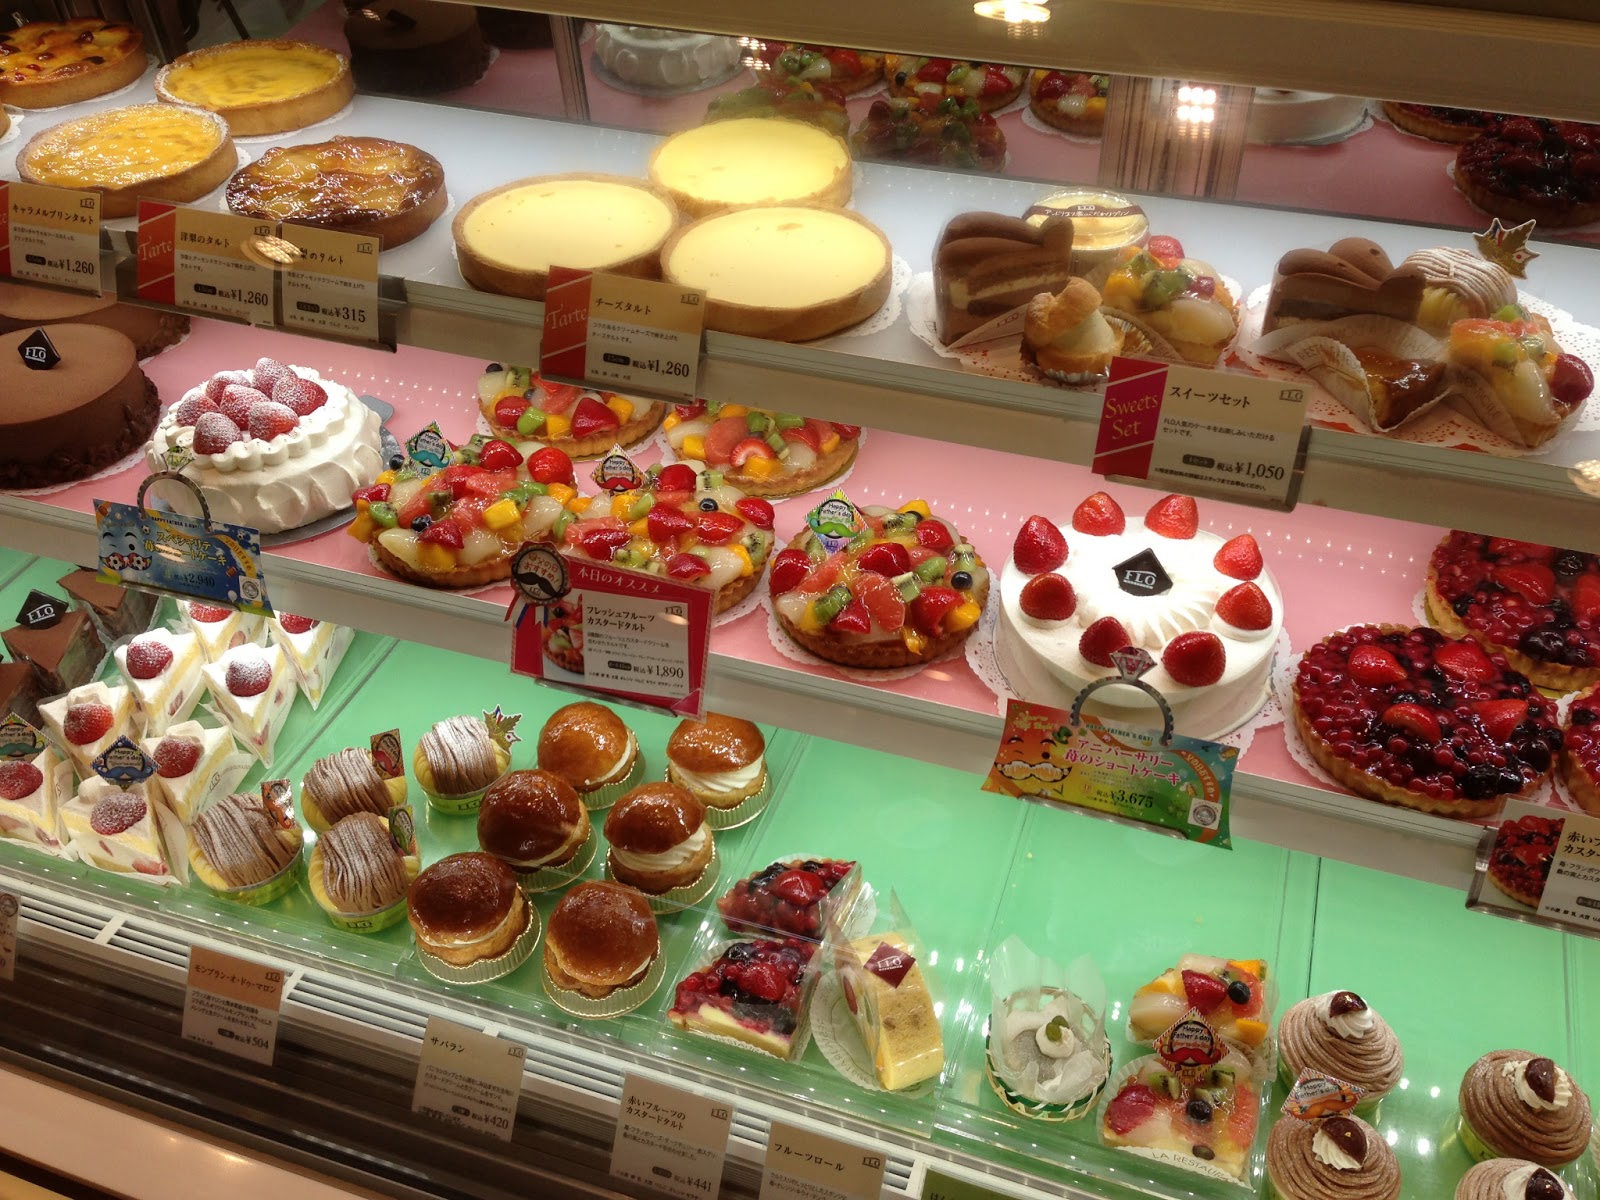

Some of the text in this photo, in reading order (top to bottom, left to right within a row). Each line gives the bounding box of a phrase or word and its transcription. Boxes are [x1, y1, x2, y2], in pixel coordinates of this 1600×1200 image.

[80, 198, 95, 209] FLO
[13, 204, 93, 224] キャラメルプリンタルト
[181, 232, 229, 248] 洋梨のタルト
[254, 225, 270, 236] FLO
[138, 235, 172, 261] Tarte
[291, 247, 344, 265] 梨のタルト
[595, 298, 651, 316] チーズタルト
[680, 293, 700, 306] FLO
[546, 304, 587, 330] Tarte
[25, 346, 47, 362] FLO
[1168, 386, 1250, 409] スイーツセット
[1279, 389, 1304, 403] FLO
[1105, 394, 1159, 419] Sweets
[1111, 419, 1142, 440] Set
[1234, 461, 1285, 481] ¥1,050
[144, 539, 227, 566] 苺ートケーキ
[578, 566, 660, 594] 本日のオススメ
[1123, 569, 1157, 589] FLO
[26, 603, 56, 624] FLO
[586, 606, 656, 622] フレッシュフルーツ
[586, 617, 646, 633] カスタードタルト
[647, 665, 684, 679] ¥1,890
[1077, 739, 1173, 767] アニバーサリー
[1064, 748, 1182, 786] 苺のショートケーキ
[876, 955, 904, 972] FLO
[1182, 1025, 1203, 1034] Happy
[431, 1037, 465, 1053] サバラン
[628, 1095, 686, 1120] 赤いフルーツの
[711, 1108, 728, 1121] FLO
[626, 1106, 684, 1130] カスタードタルト
[775, 1143, 844, 1171] フルーツロール
[862, 1156, 880, 1169] FLO
